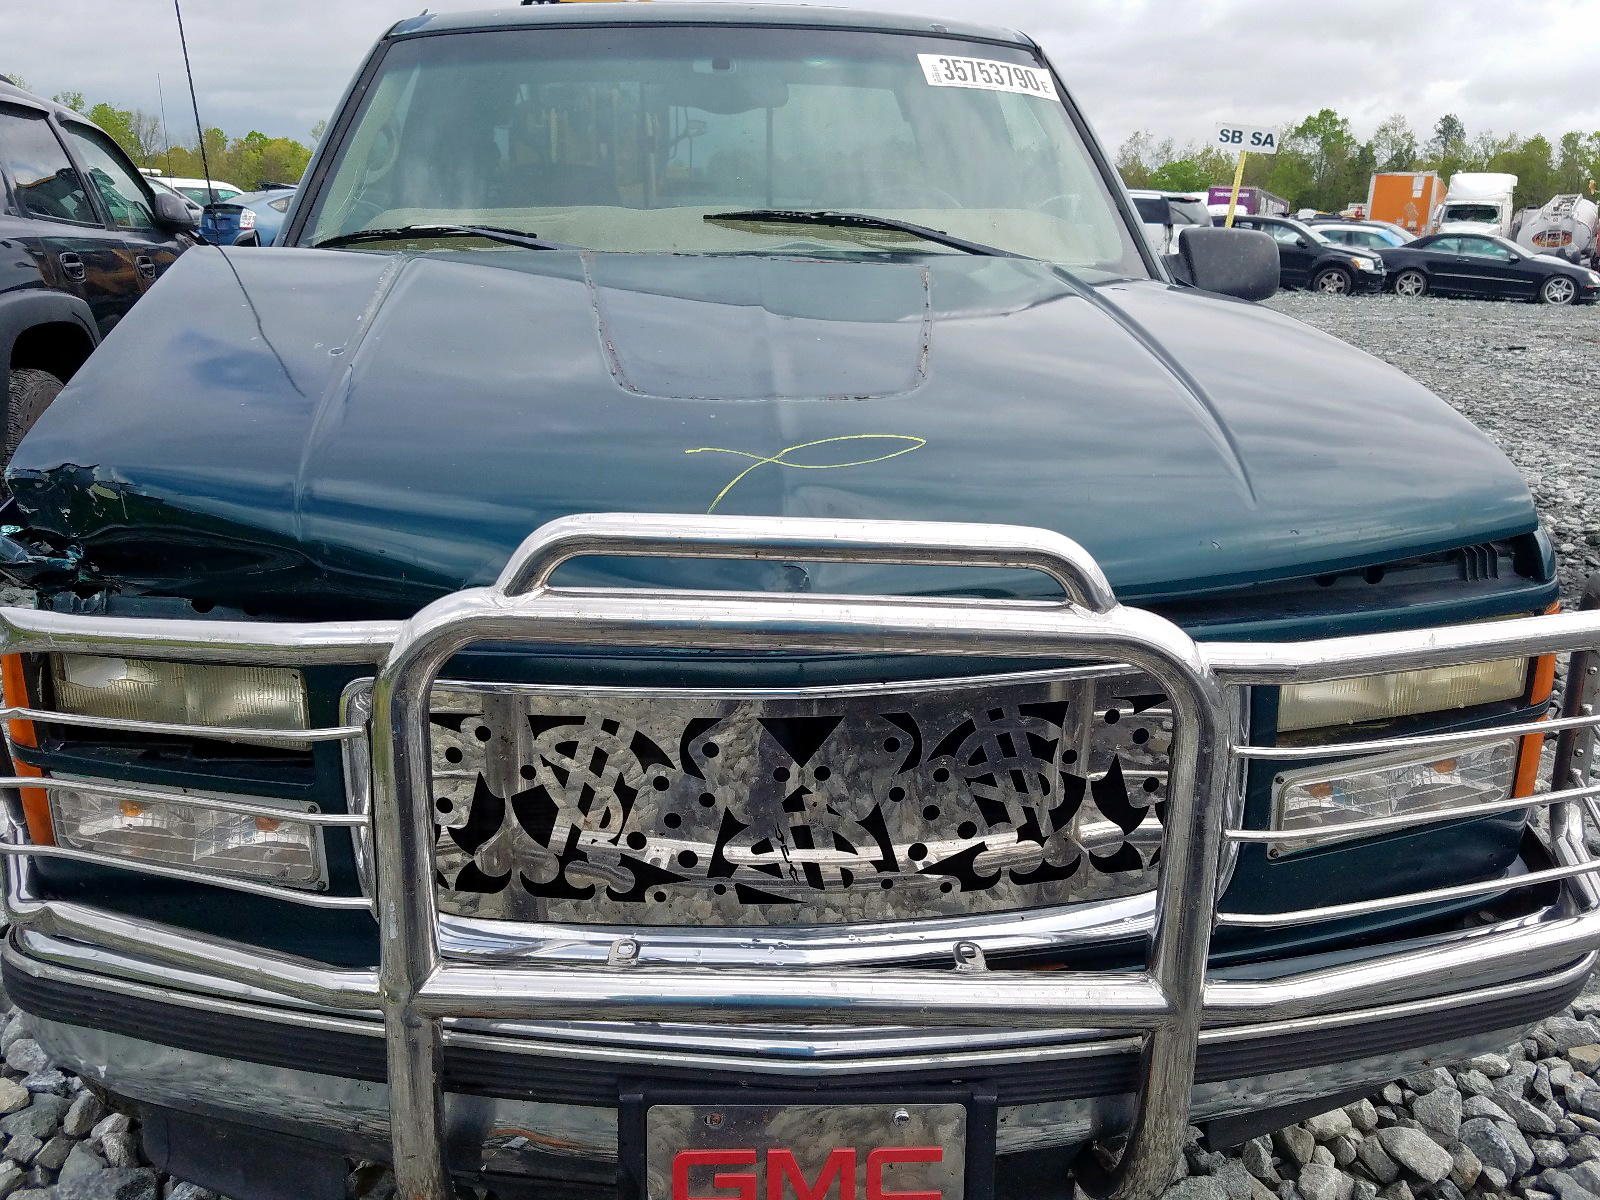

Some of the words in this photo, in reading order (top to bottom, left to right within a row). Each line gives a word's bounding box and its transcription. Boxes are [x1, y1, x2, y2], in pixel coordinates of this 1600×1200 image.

[939, 58, 1041, 92] 35753790
[1219, 128, 1244, 144] SB
[1250, 131, 1275, 148] SA
[672, 1146, 944, 1200] GMC
